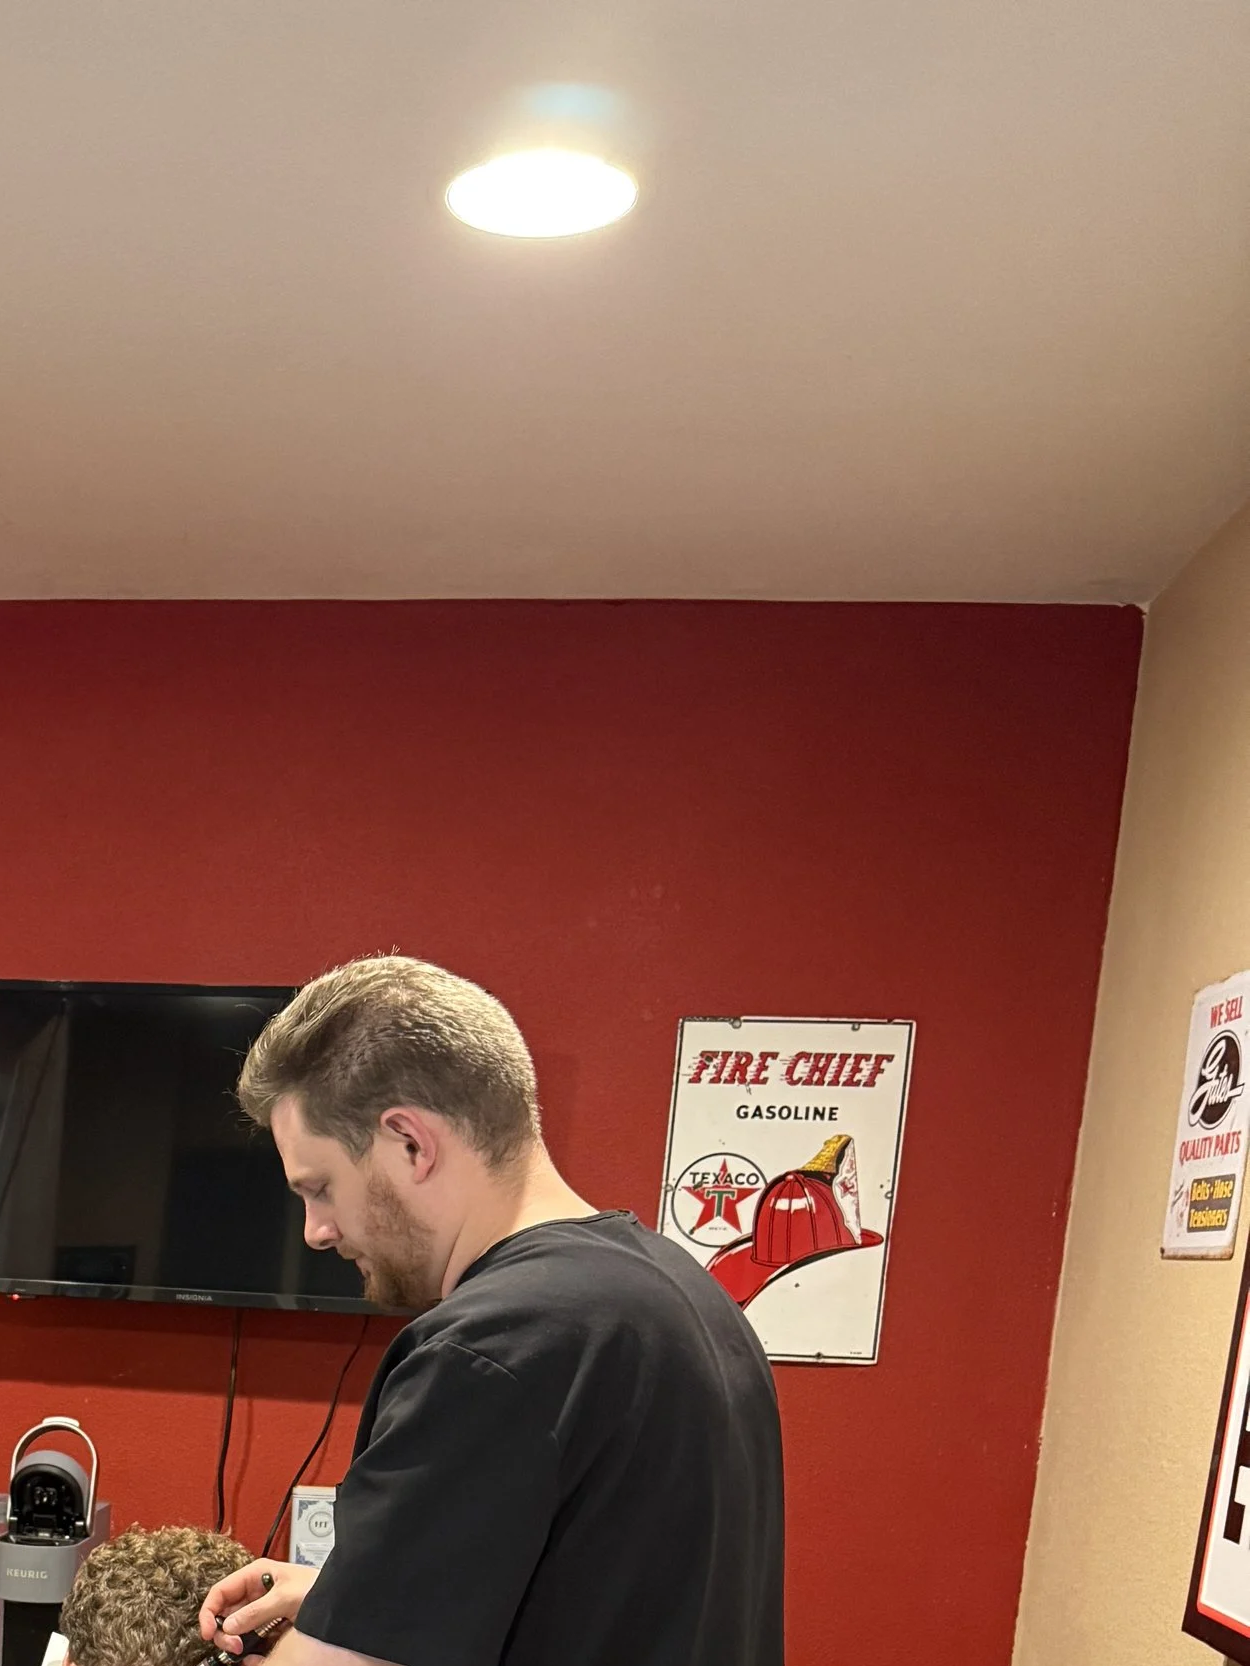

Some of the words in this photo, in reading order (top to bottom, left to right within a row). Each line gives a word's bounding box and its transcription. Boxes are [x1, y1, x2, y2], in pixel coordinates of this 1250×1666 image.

[1210, 1003, 1224, 1029] WE
[1224, 996, 1243, 1024] SELL
[687, 1051, 779, 1084] FIRE
[784, 1051, 895, 1088] CHIEF
[736, 1105, 840, 1121] GASOLINE
[1179, 1136, 1213, 1167] QUALITY
[689, 1172, 759, 1186] TEXACO
[176, 1293, 212, 1301] INSIGNIA
[6, 1567, 48, 1580] KEURIG
